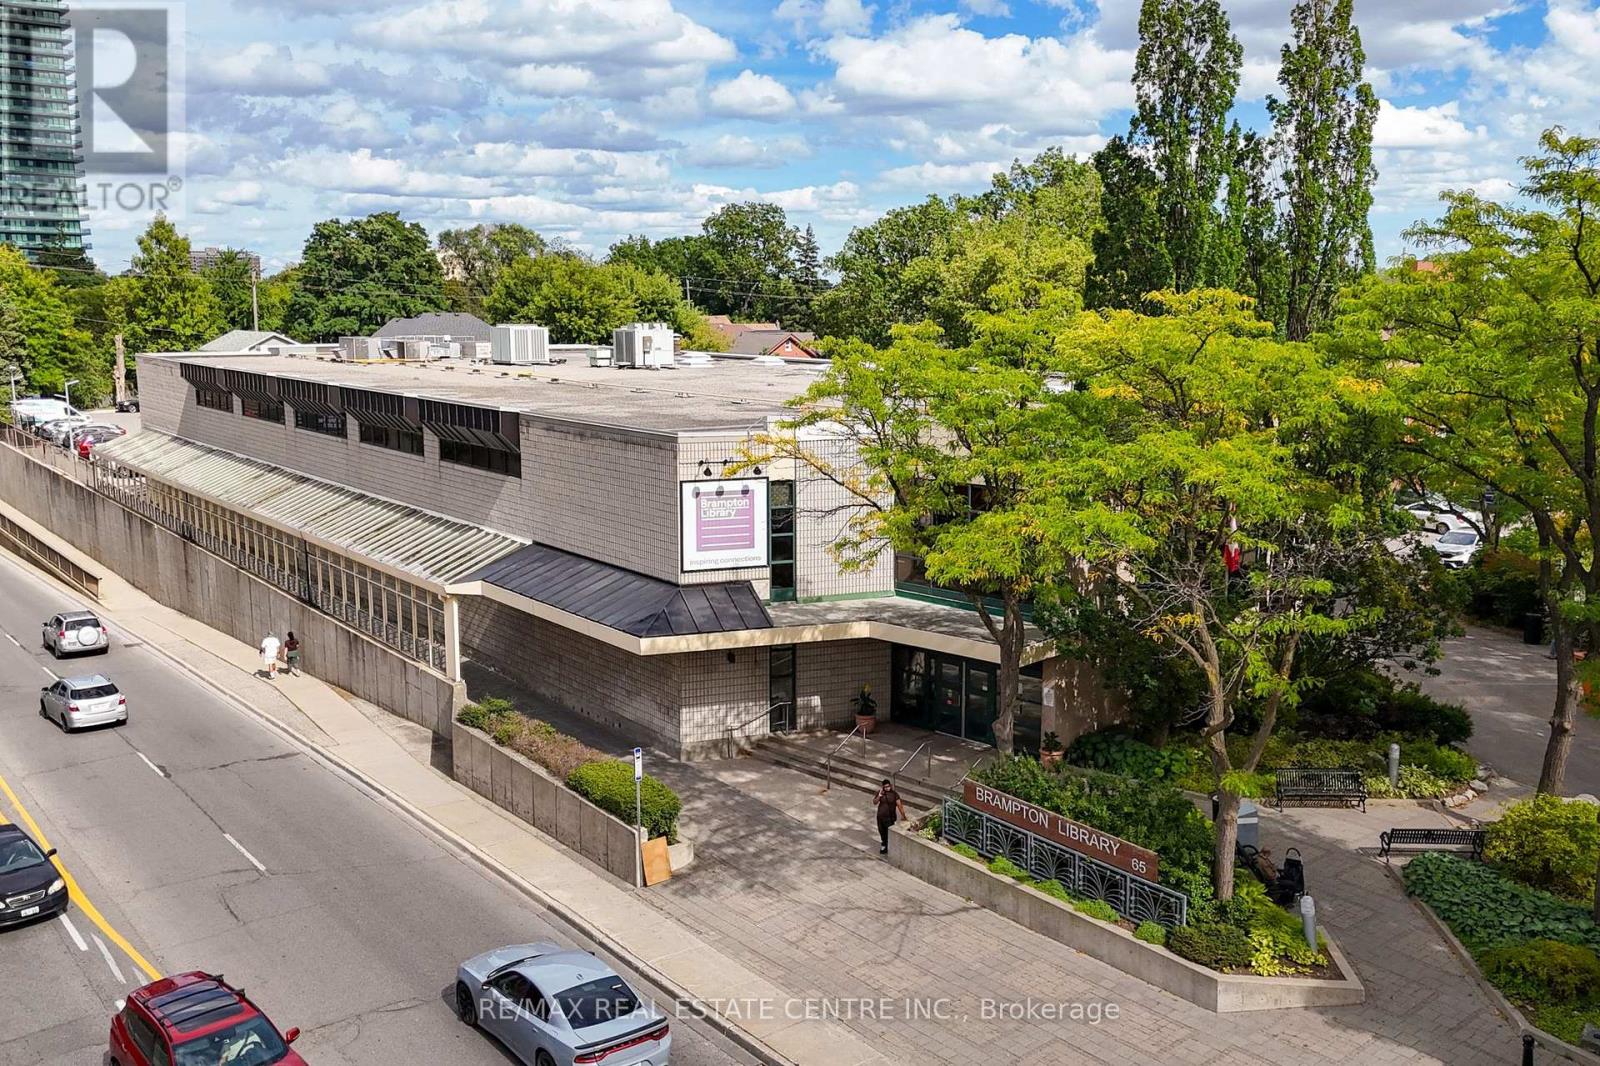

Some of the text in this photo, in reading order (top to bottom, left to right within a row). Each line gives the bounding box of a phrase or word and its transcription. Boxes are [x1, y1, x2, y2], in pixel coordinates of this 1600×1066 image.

[700, 498, 750, 510] Brampton
[701, 508, 737, 518] Library
[975, 787, 1121, 857] BRAMPTON LIBRARY
[1131, 857, 1147, 875] 65
